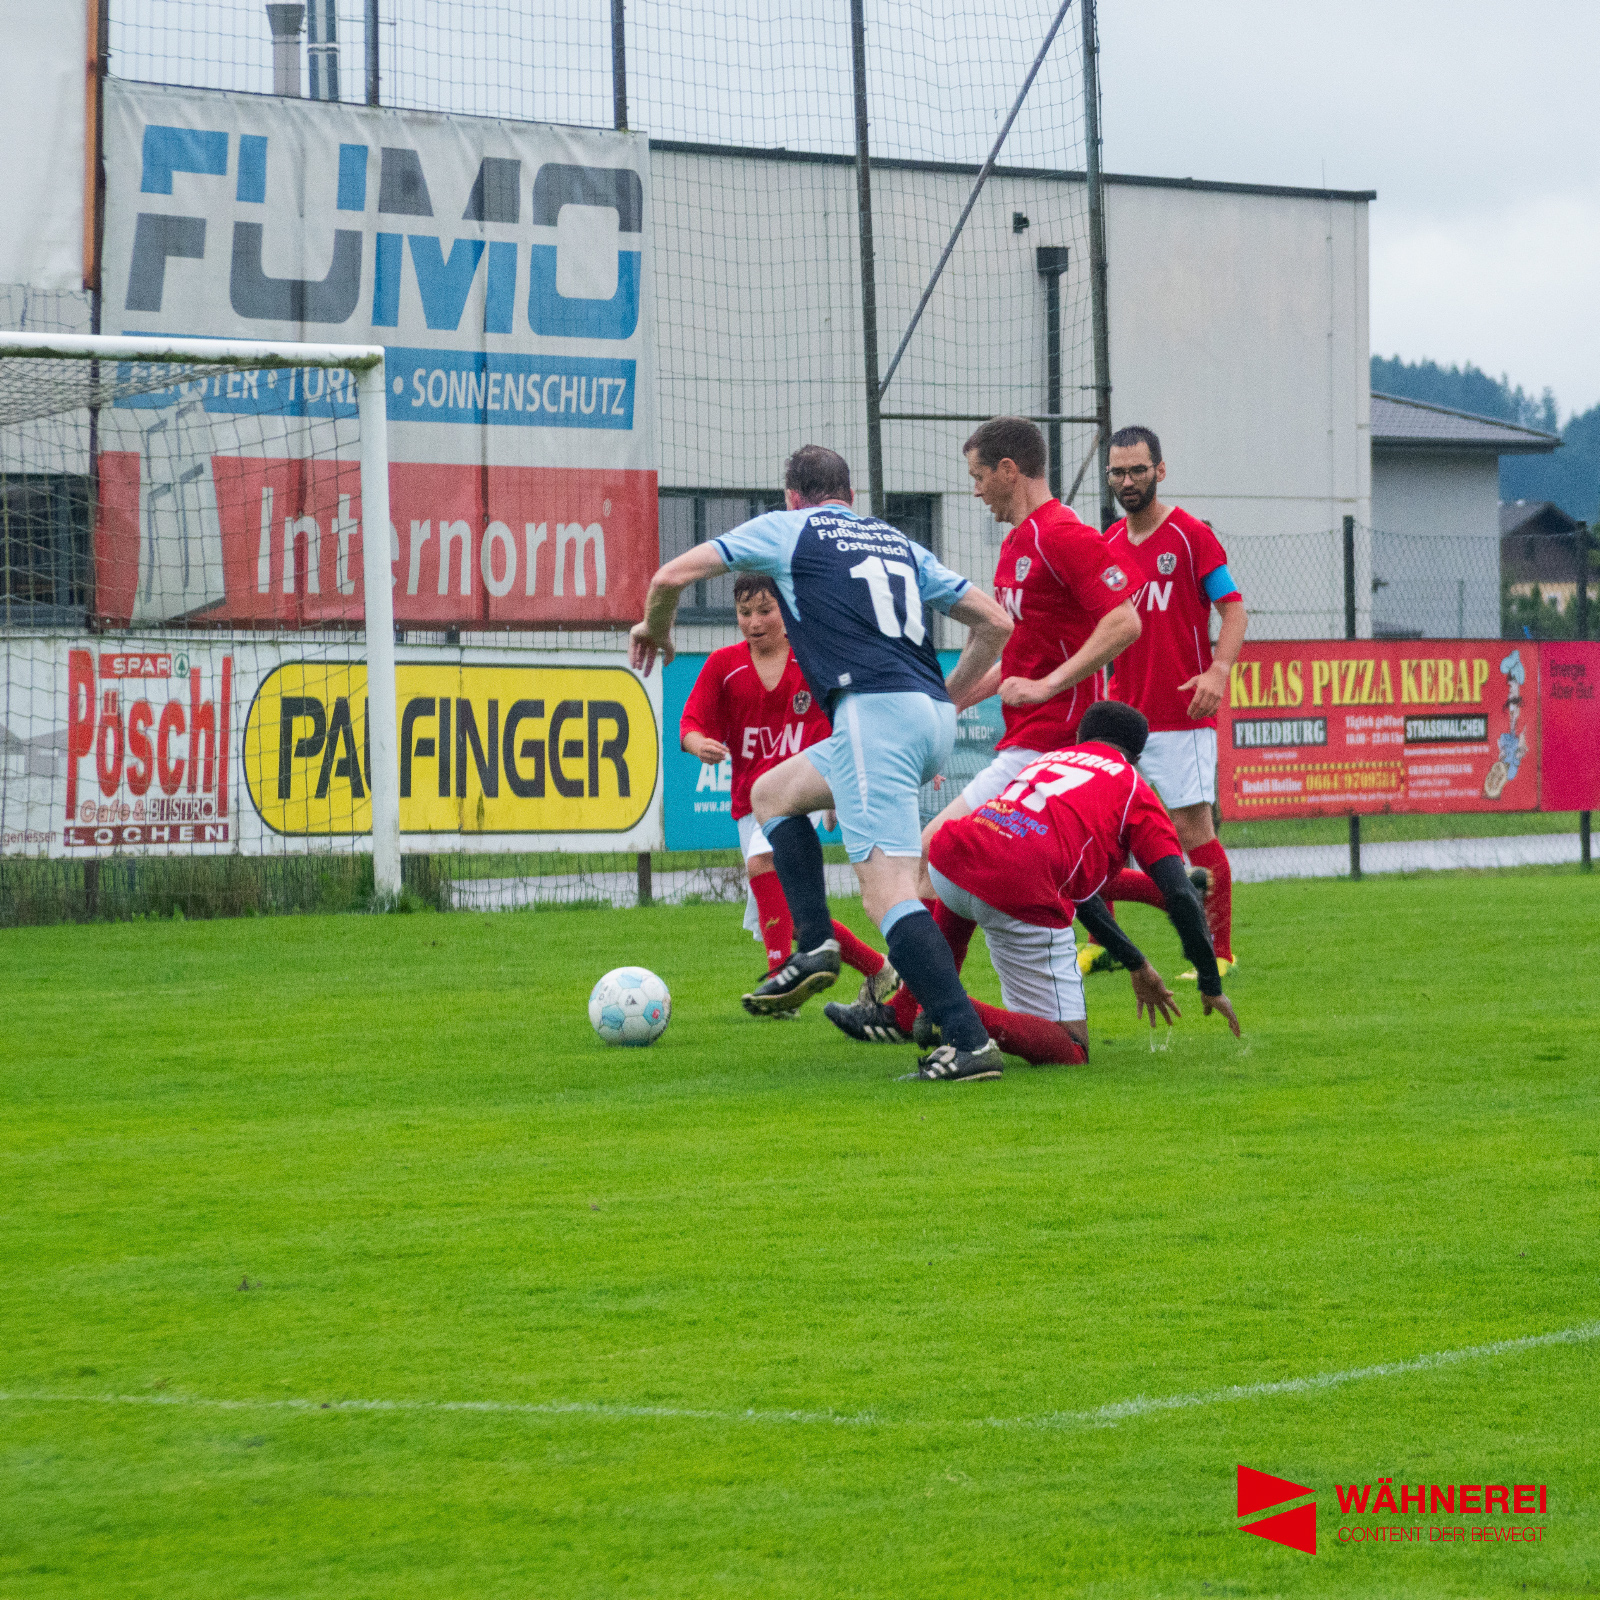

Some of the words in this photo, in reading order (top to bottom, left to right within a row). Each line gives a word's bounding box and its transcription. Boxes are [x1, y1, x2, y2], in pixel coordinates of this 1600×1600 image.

[125, 124, 643, 339] FUMO
[411, 368, 627, 415] SONNENSCHUTZ
[257, 487, 607, 597] Intrnorm
[836, 539, 908, 557] Österreich
[849, 556, 925, 646] 17
[113, 657, 171, 675] SPAR
[1230, 660, 1303, 708] KLAS
[1312, 659, 1394, 706] PIZZA
[1401, 658, 1489, 704] KEBAP
[66, 649, 233, 820] Pöschl
[278, 696, 631, 799] PAFINGER
[742, 722, 804, 759] EVN
[1235, 720, 1326, 745] FRIEDBURG
[1406, 719, 1485, 739] STRASSWALCHEN
[1029, 751, 1125, 776] USTRIA
[1000, 762, 1095, 813] 17
[149, 798, 215, 821] BISTRO
[68, 825, 224, 846] LOCHEN
